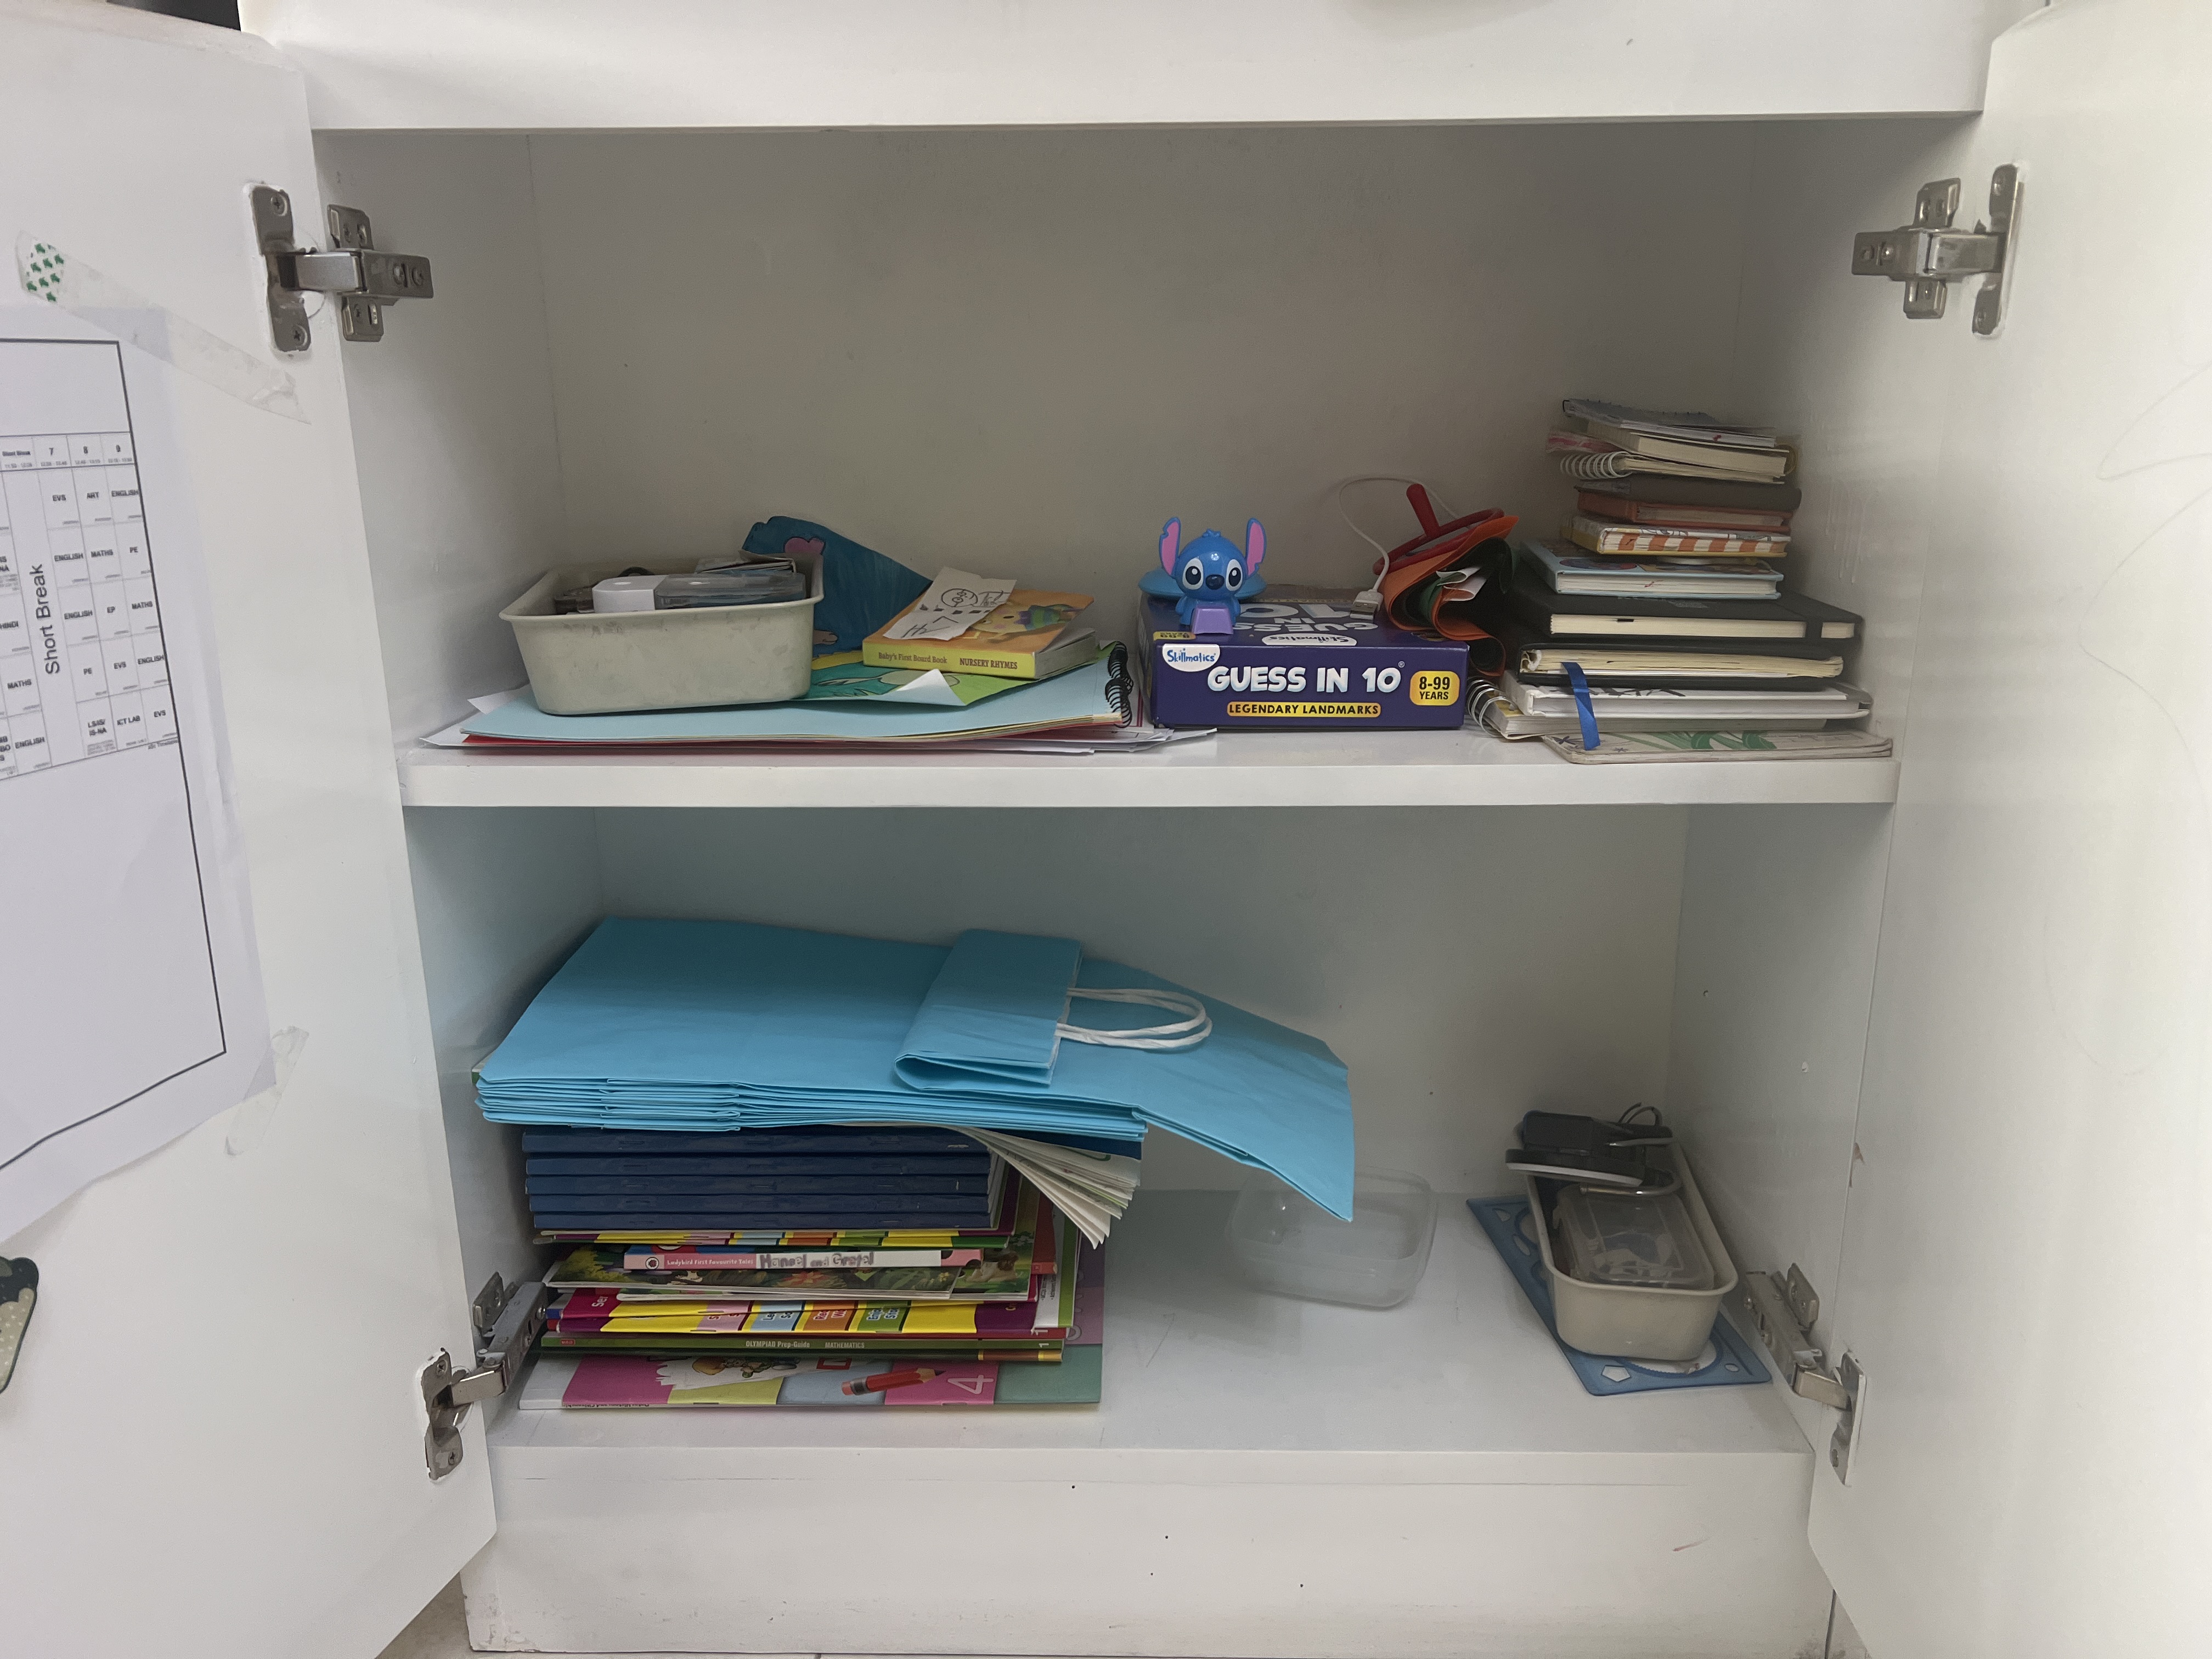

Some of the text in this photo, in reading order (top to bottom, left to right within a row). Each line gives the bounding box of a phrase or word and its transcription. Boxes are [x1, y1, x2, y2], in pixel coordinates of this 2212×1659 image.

[49, 447, 54, 456] 7
[83, 445, 89, 454] 8
[111, 489, 139, 498] ENGLISH
[54, 552, 84, 562] ENGLISH
[91, 549, 114, 558] MATHS
[131, 601, 153, 610] MATHS
[29, 564, 60, 674] Short Break
[64, 610, 93, 620] ENGLISH
[1232, 622, 1379, 632] GUESS
[1269, 635, 1350, 644] Skillmatics
[137, 654, 165, 665] ENGLISH
[878, 652, 947, 664] Baby's First Board Book
[1167, 648, 1215, 663] Skillmatics
[113, 661, 127, 670] EVS
[959, 657, 1018, 670] NURSERY RHYMES
[1207, 665, 1306, 693] GUESS
[1317, 667, 1349, 693] IN
[1419, 676, 1451, 691] 8-99
[7, 679, 32, 690] MATHS
[1419, 691, 1449, 701] YEARS
[153, 710, 167, 718] EVS
[1229, 703, 1379, 715] LEGENDARY LANDMARKS
[128, 715, 140, 724] LAB
[15, 736, 45, 749] ENGLISH
[667, 1259, 693, 1267] Ladybird
[810, 1257, 829, 1267] and
[832, 1252, 874, 1267] Gretel
[746, 1340, 865, 1349] OLYMPIAD Prep-Guide MATHEMATICS
[947, 1374, 995, 1395] 4
